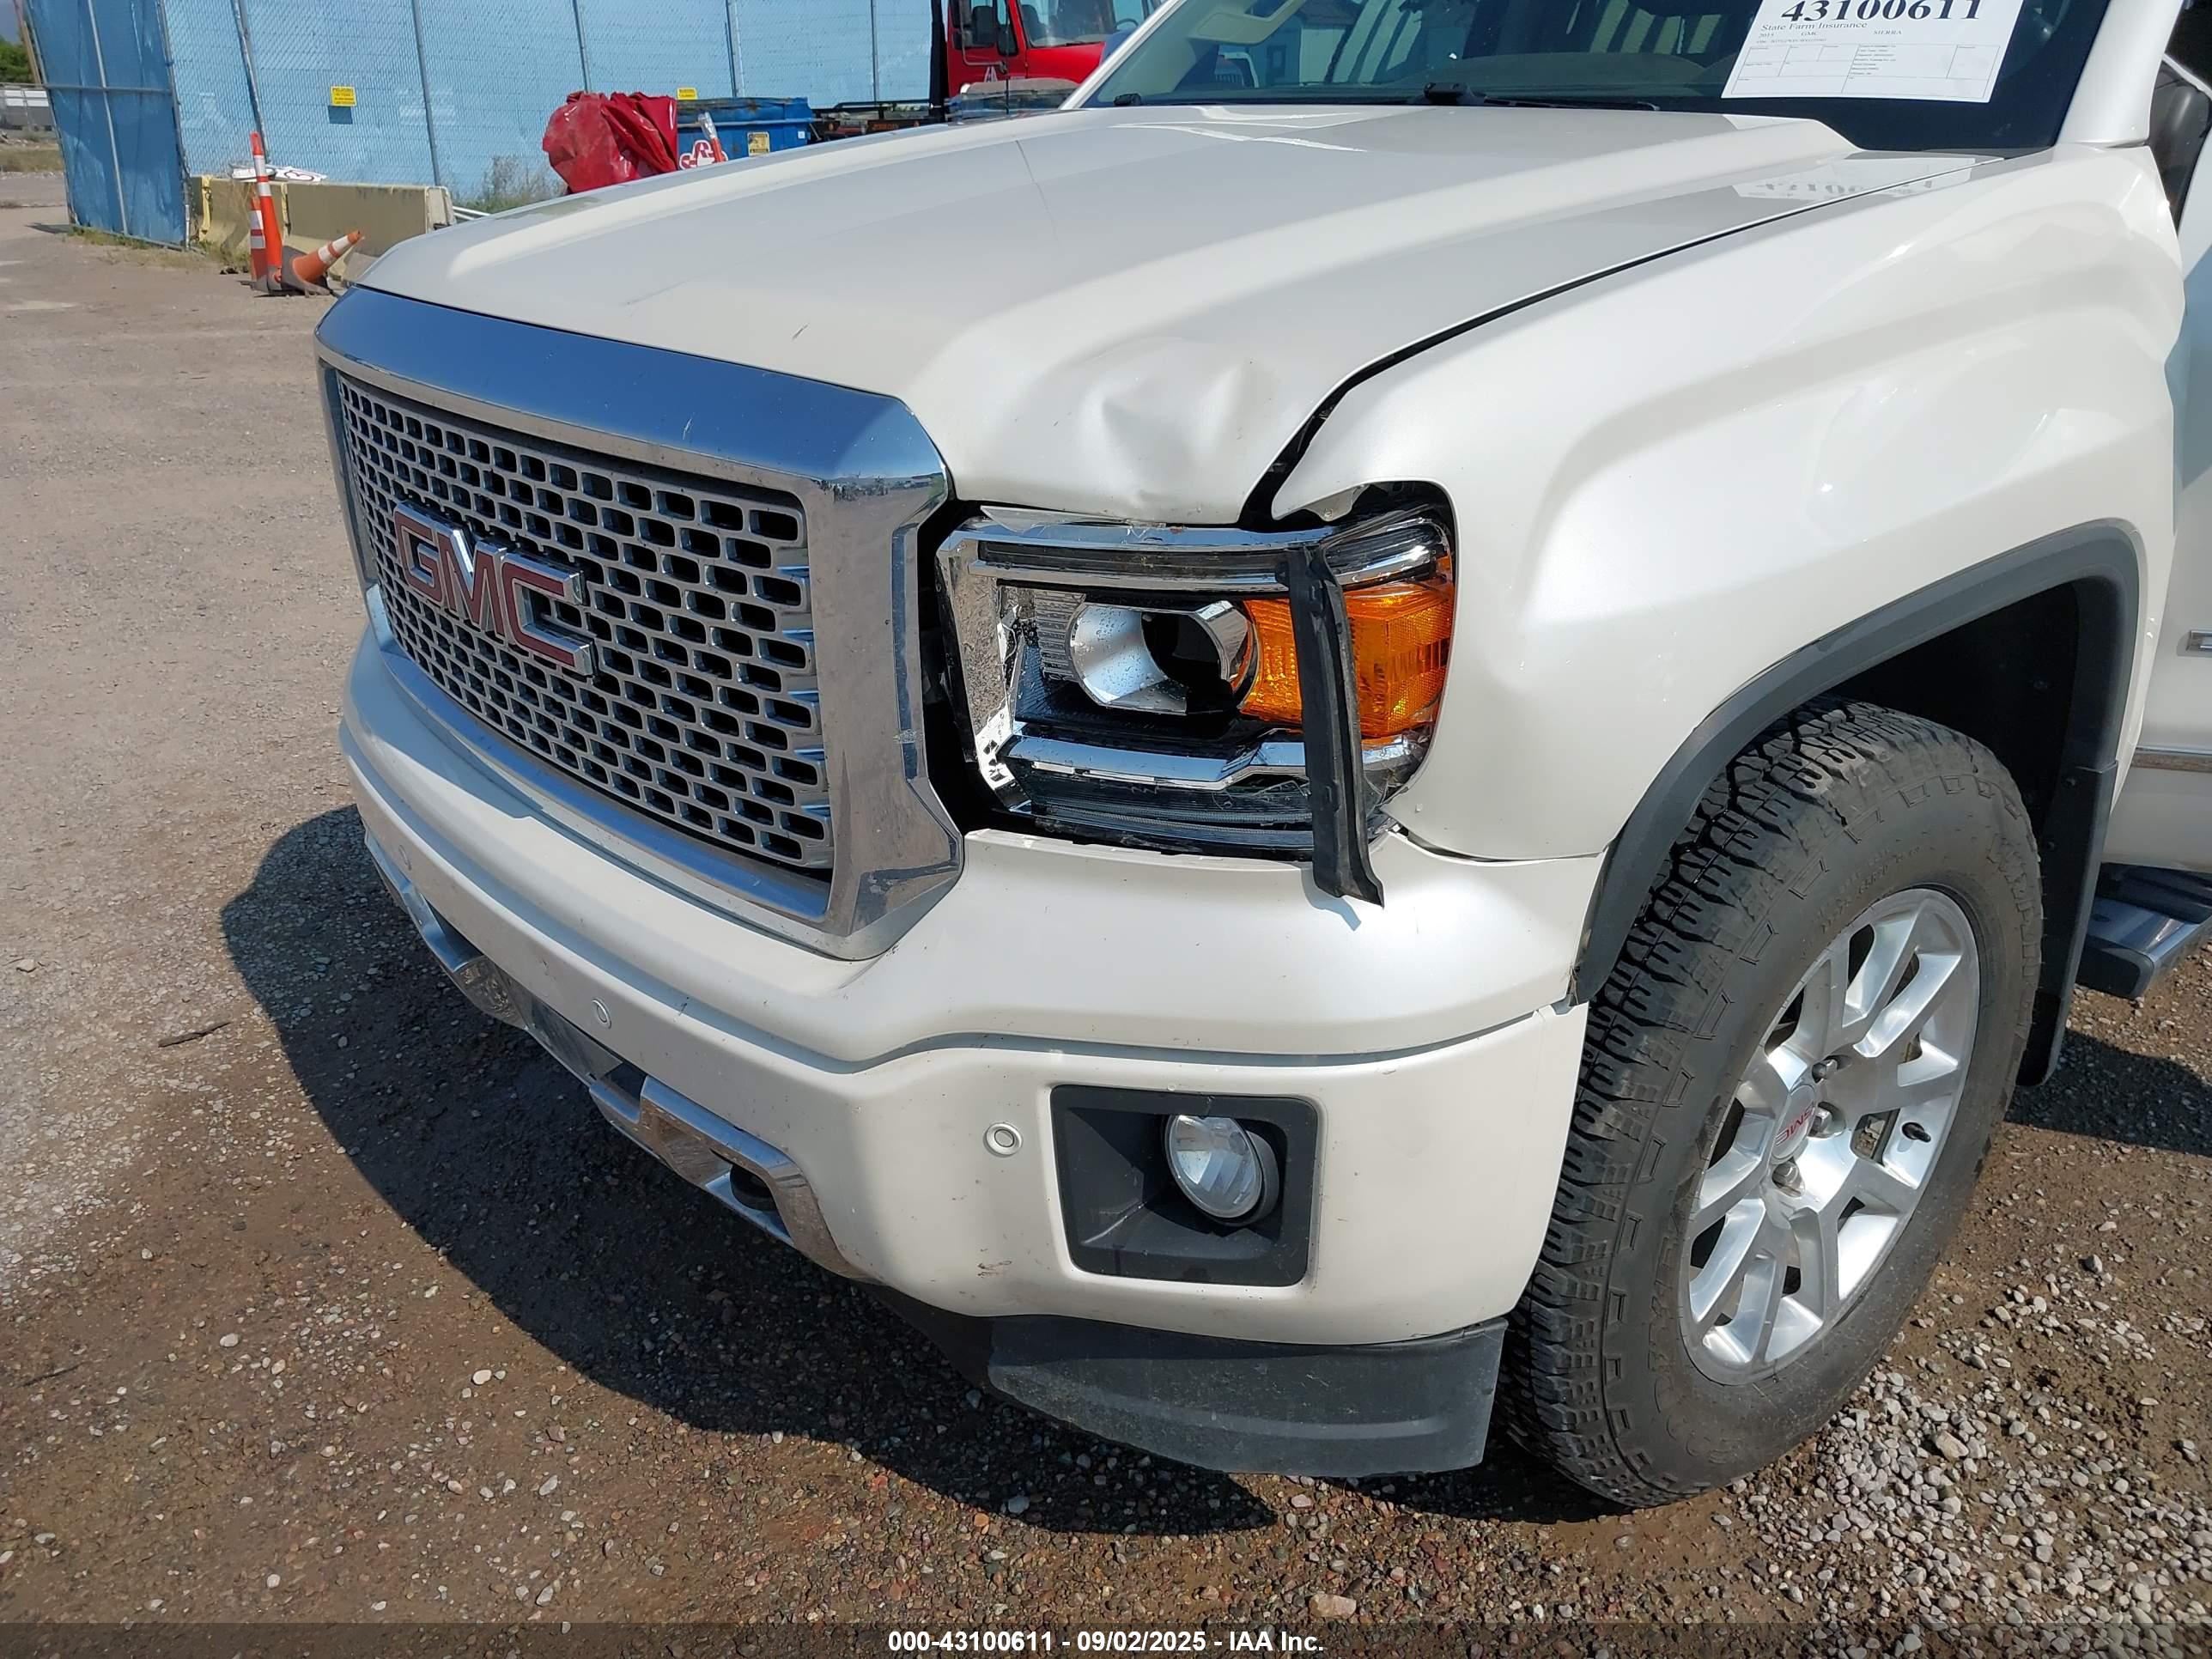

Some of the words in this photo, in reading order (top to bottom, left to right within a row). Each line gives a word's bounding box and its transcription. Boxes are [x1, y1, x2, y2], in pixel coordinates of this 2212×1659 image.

[1781, 0, 1979, 21] 43100611
[394, 499, 594, 676] GMC
[1775, 1101, 1815, 1146] GMC
